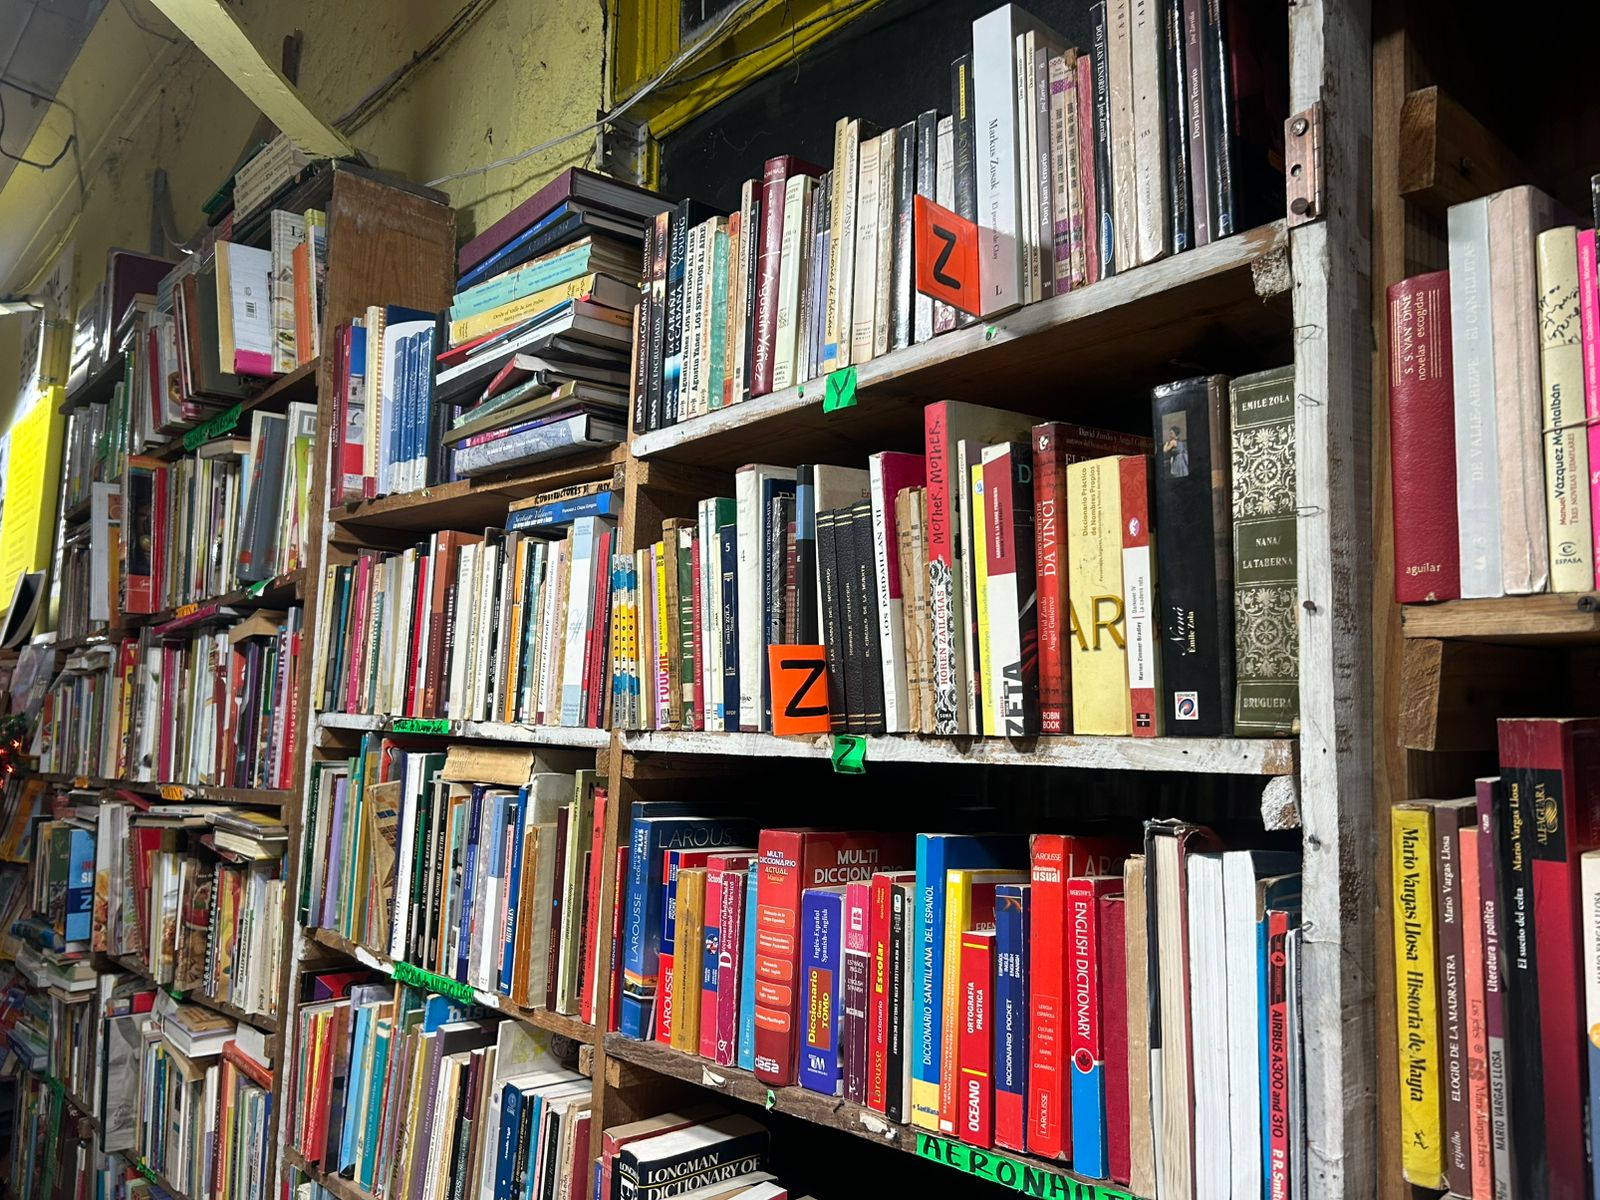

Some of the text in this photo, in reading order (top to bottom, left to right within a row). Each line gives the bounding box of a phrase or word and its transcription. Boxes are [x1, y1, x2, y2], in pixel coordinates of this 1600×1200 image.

[1096, 42, 1104, 61] JUAN
[1097, 61, 1105, 95] TENORIO
[1190, 69, 1201, 139] Don Juan Tenorio
[987, 118, 1001, 191] Markus Zusak
[1038, 153, 1050, 224] Don Juan Tenorio
[676, 217, 686, 265] YOUNG
[695, 225, 706, 310] SENTIDOS AIRE
[933, 224, 961, 289] Z
[667, 222, 679, 341] CABAÑA YOUNG
[685, 230, 696, 316] SENTIDOS AIRE
[652, 317, 661, 378] ENCRUCIJADA
[754, 272, 774, 380] Agustín Yáñez
[1402, 293, 1413, 352] VAN DINE
[1416, 290, 1427, 380] novelas escogidas
[832, 368, 853, 399] Y
[1242, 394, 1291, 413] EMILE ZOLA
[1549, 383, 1567, 526] Manuel Vázquez Montalbán
[1566, 432, 1579, 525] TRES NOVELAS EJEMPLARES
[1080, 467, 1089, 536] Diccionario Práctico
[1088, 465, 1098, 526] Nombres Propios
[1042, 499, 1057, 577] DA VINCI
[1254, 556, 1293, 568] TABERNA
[1256, 536, 1278, 547] NANA
[1405, 562, 1441, 575] aguilar
[877, 531, 888, 608] PARDAILLAN
[682, 594, 694, 659] FOUCHE
[936, 590, 948, 645] ZAILCKAS
[1040, 596, 1049, 641] David Zurdo
[1046, 596, 1056, 628] Gutiérrez
[1135, 621, 1143, 641] Bradley
[1186, 611, 1196, 630] Zola
[660, 652, 671, 704] FOUCHE
[781, 661, 828, 717] Z
[1003, 661, 1024, 736] ZETA
[1242, 696, 1293, 709] BRUGUERA
[1042, 712, 1060, 720] ROBIN
[1042, 721, 1060, 730] BOOK
[1508, 782, 1523, 871] Mario Vargas Llosa
[1535, 783, 1549, 845] ALFAGUARA
[759, 855, 797, 868] DICCIONARIO
[765, 867, 789, 875] ACTUAL
[766, 849, 784, 858] MULTI
[837, 849, 879, 866] MULTI
[1032, 869, 1061, 883] usual
[1441, 835, 1453, 923] Mario Vargas Llosa
[1402, 826, 1421, 961] Mario Vargas Llosa
[1515, 887, 1526, 956] sueño del celta
[505, 907, 514, 943] ORO GRIS
[630, 892, 642, 963] LAROUSSE
[813, 909, 821, 960] Inglés-Español
[820, 908, 829, 963] Spanish-English
[1483, 900, 1498, 992] Literatura política
[922, 885, 934, 1066] DICCIONARIO SANTILLANA DEL ESPAÑOL
[1074, 901, 1092, 1041] ENGLISH DICTIONARY
[662, 967, 674, 1038] LAROUSSE
[808, 970, 819, 1043] Diccionario
[820, 991, 829, 1029] TOMO
[872, 941, 885, 1104] Larousse diccionario Escolar
[966, 982, 975, 1034] ORTOGRAFÍA
[974, 989, 984, 1030] PRÁCTICA
[1445, 954, 1461, 1102] ELOGIO DE LA MADRASTRA
[1005, 998, 1014, 1087] DICCIONARIO POCKET
[1406, 969, 1426, 1103] Historia de Mayta
[1271, 1008, 1284, 1138] AIRBUS A300 and 310
[1491, 1050, 1507, 1151] MARIO VARGAS LLOSA
[968, 1080, 980, 1132] OCEANO
[1039, 1092, 1048, 1135] LAROUSSE
[646, 1157, 760, 1200] DICTIONARY OF
[647, 1151, 720, 1185] LONGMAN
